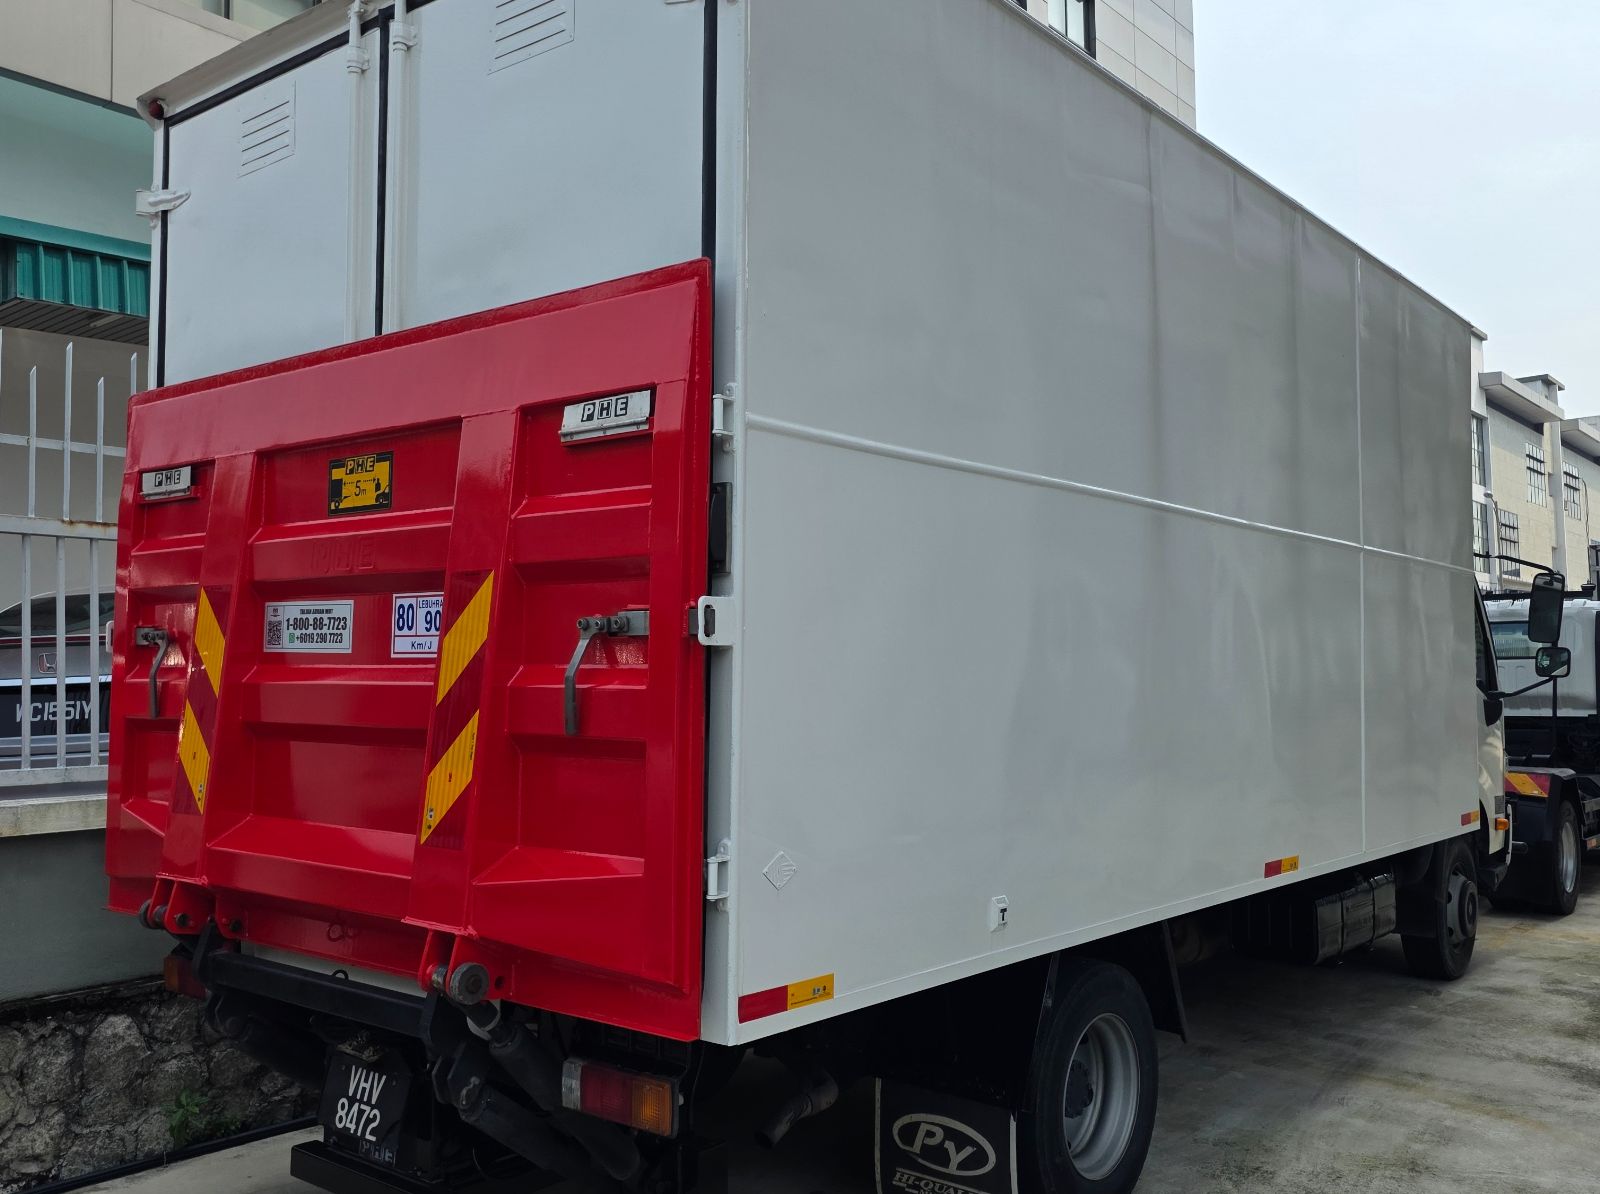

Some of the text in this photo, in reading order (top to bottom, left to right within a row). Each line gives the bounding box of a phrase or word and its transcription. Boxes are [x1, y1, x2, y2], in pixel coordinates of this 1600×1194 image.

[581, 396, 629, 423] PHE
[345, 456, 376, 475] PHE
[155, 470, 181, 487] PHE
[286, 616, 347, 631] 1-800-88-7723
[396, 603, 415, 632] 80
[424, 609, 442, 632] 90
[296, 632, 343, 644] +6019 290 7723
[348, 1065, 387, 1105] VHV
[335, 1097, 380, 1141] 8472
[912, 1122, 976, 1171] PY
